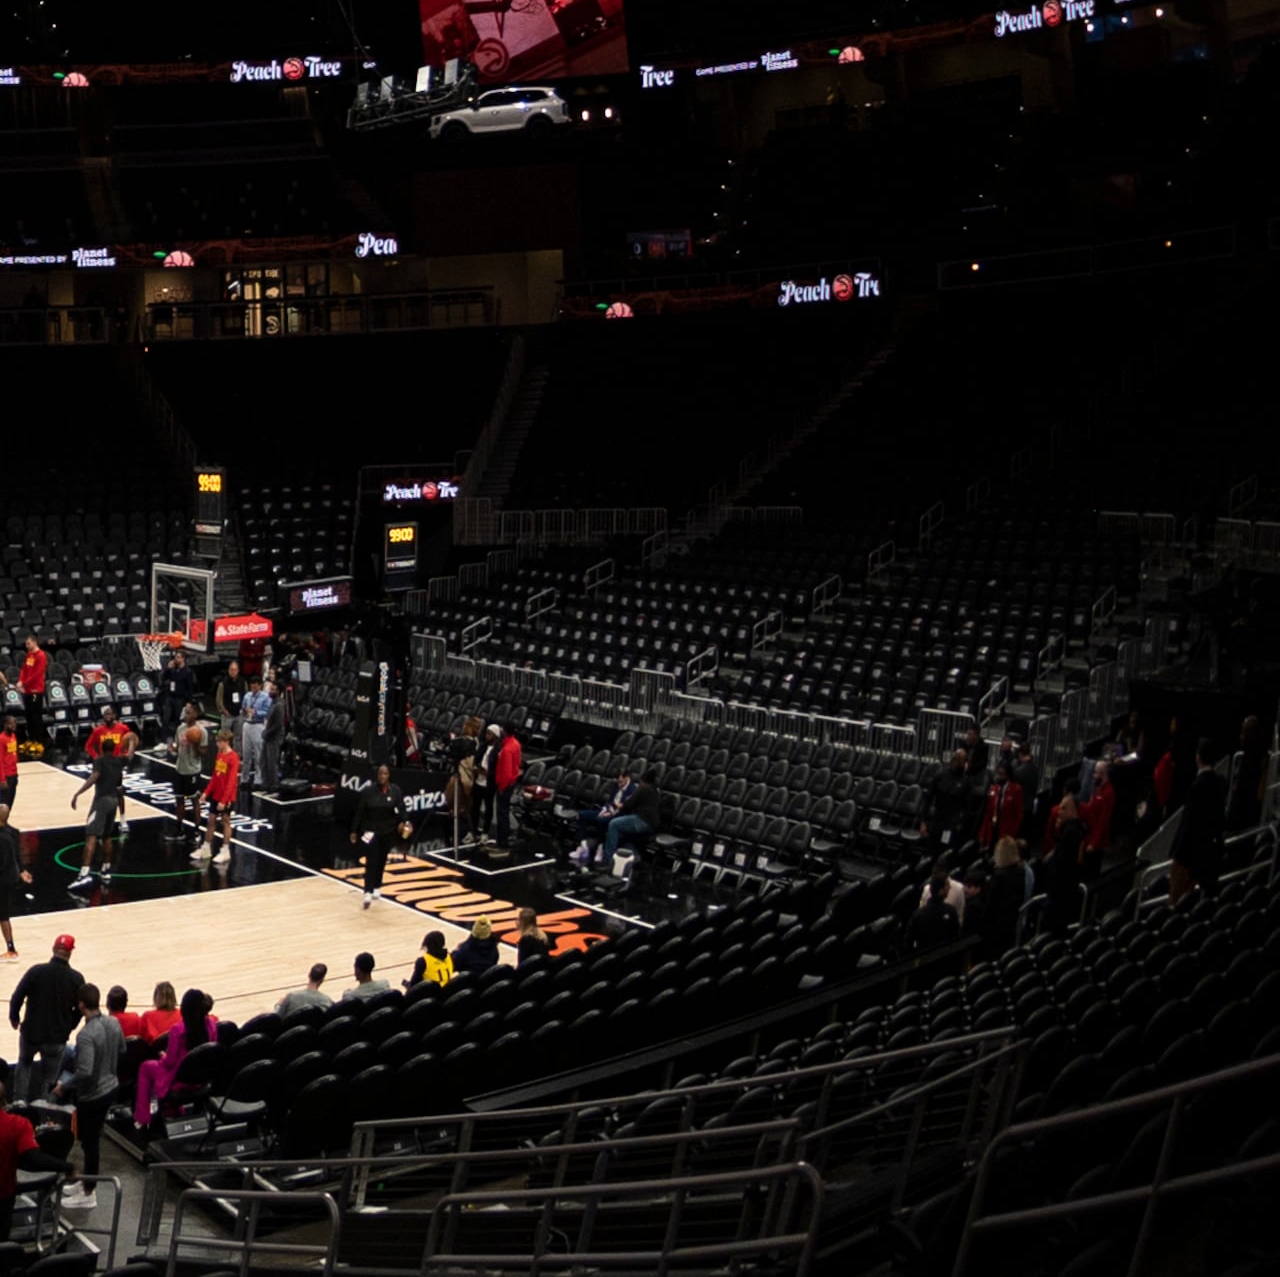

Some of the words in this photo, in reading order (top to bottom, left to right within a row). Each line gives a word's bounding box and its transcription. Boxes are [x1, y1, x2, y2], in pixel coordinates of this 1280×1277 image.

[995, 5, 1041, 36] Peach
[230, 60, 281, 82] Peach
[304, 57, 340, 77] Tree
[640, 66, 673, 88] Tree
[356, 233, 397, 257] Pea
[71, 248, 108, 267] planet
[76, 257, 116, 267] fitness
[779, 278, 830, 305] Peach
[854, 273, 879, 297] Tre
[383, 484, 421, 501] Peach
[402, 789, 446, 812] erizo
